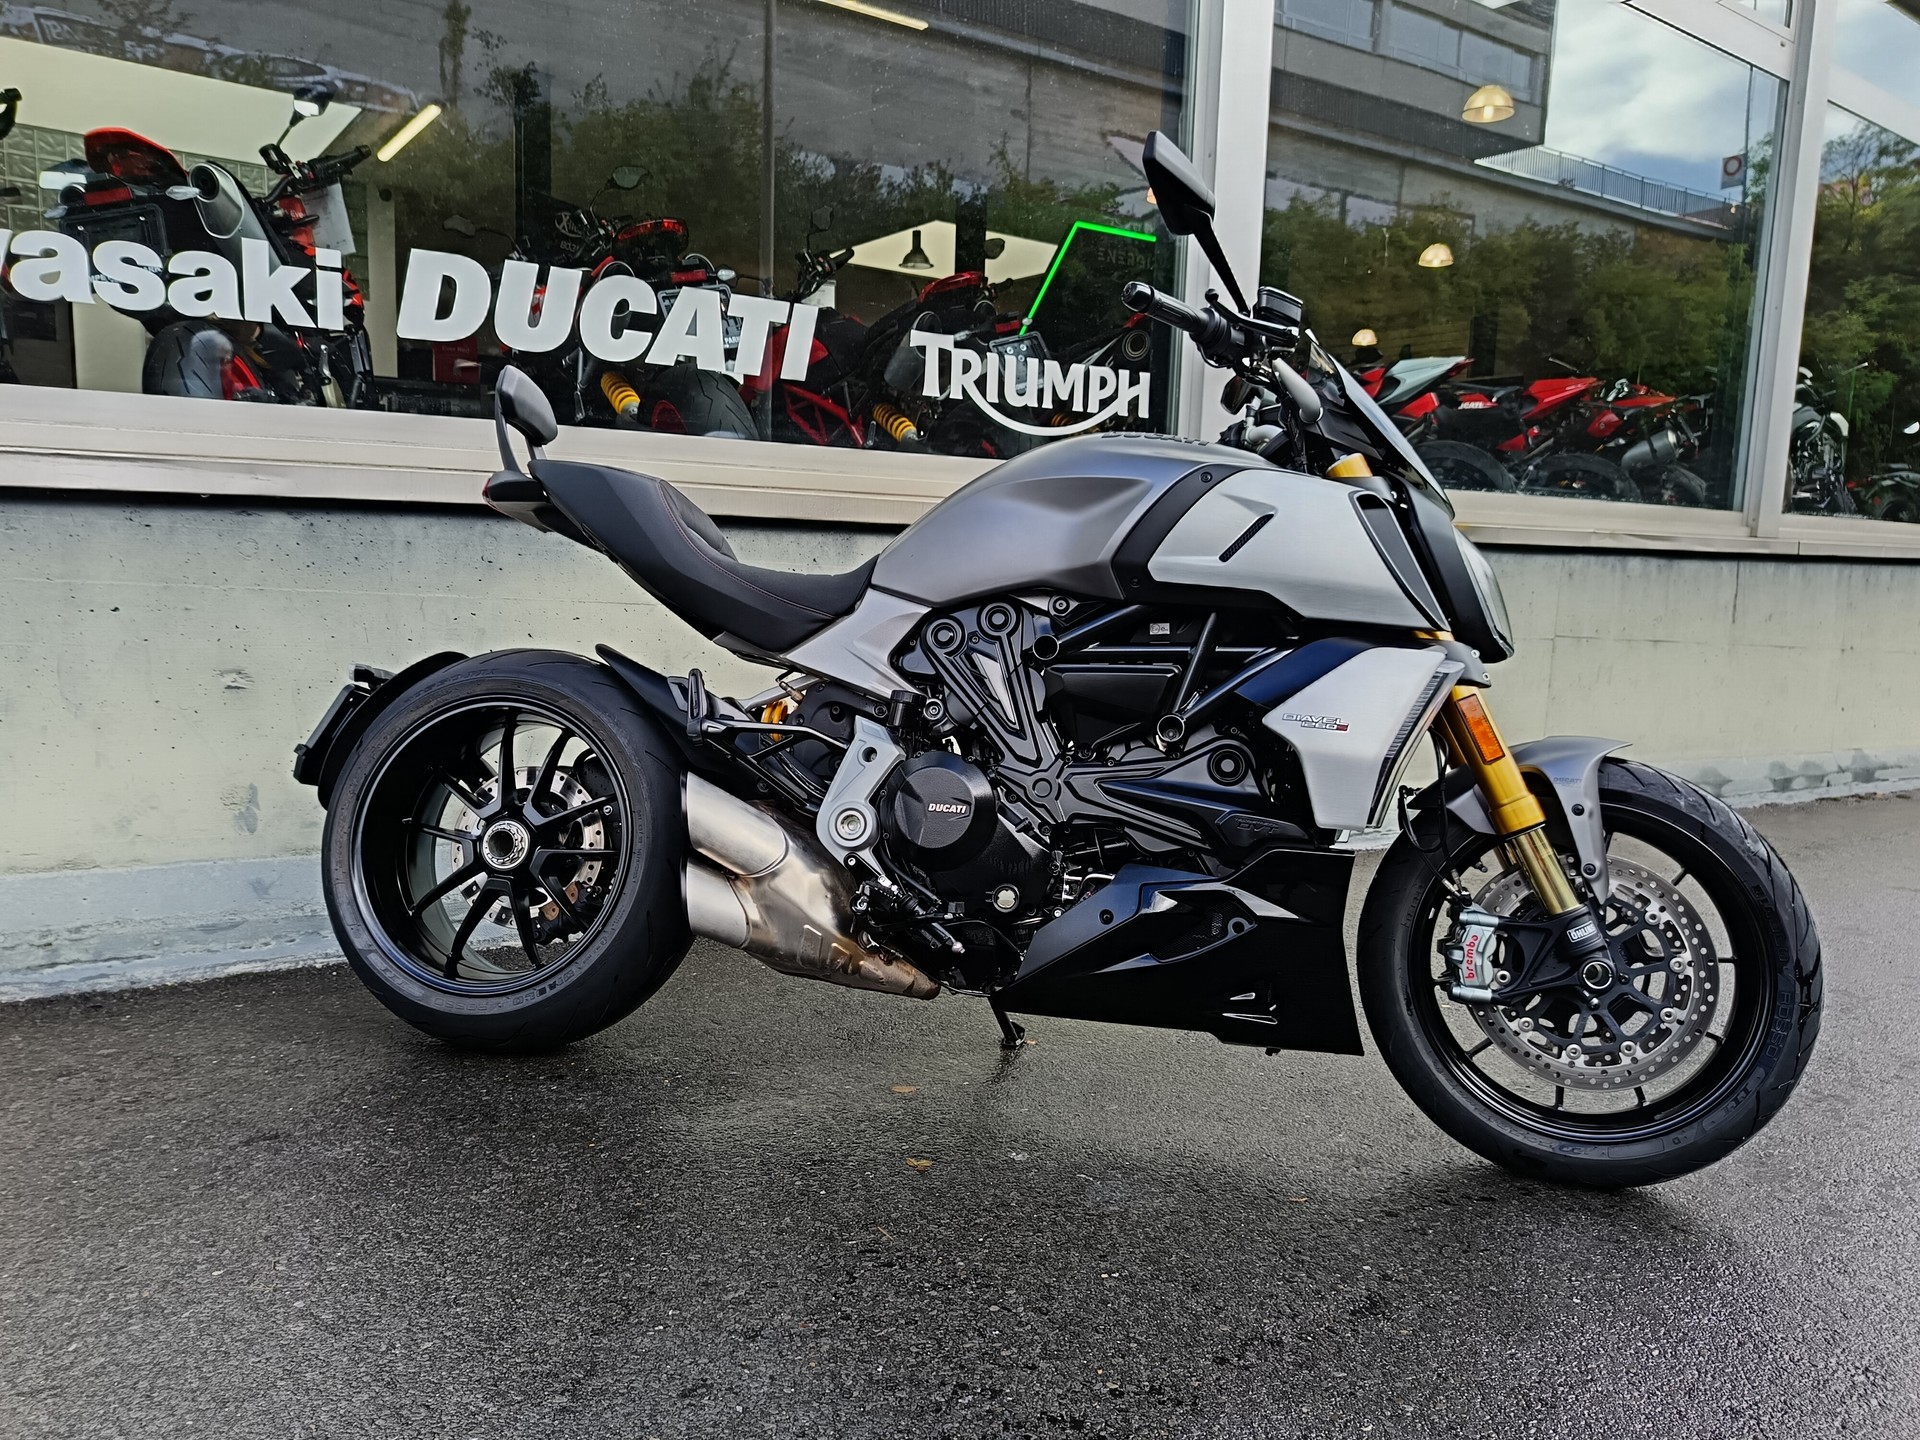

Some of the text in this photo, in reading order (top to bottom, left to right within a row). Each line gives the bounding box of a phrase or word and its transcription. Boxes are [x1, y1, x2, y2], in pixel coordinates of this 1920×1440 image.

[0, 229, 344, 330] asaki
[396, 248, 818, 381] DUCATI
[910, 329, 1150, 436] TRIUMPH
[1282, 714, 1349, 726] DIAVEL
[928, 803, 967, 814] DUCATI
[1465, 935, 1479, 979] brembo
